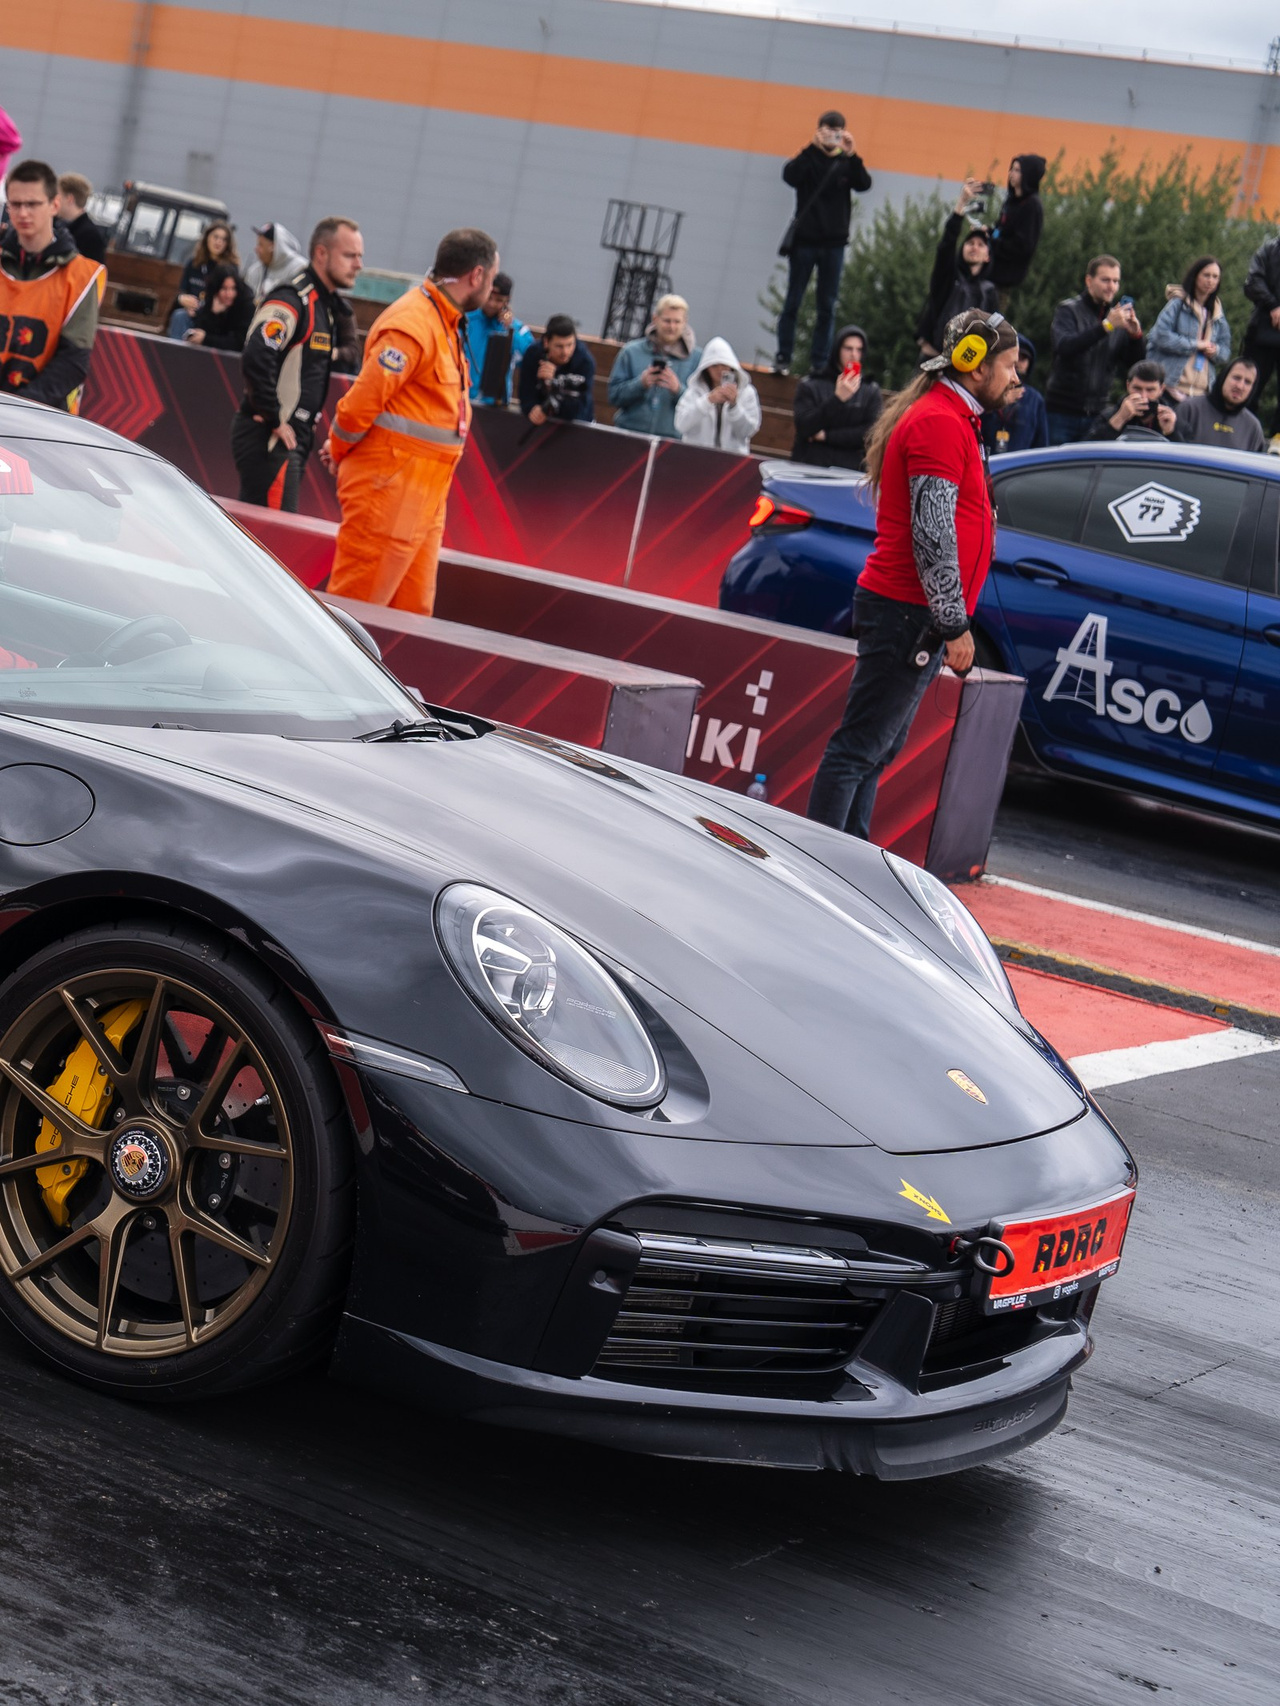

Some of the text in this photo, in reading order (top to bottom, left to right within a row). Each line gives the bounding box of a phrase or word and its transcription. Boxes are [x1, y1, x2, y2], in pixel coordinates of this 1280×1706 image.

[1138, 502, 1165, 522] 77
[49, 1074, 80, 1146] POCHE
[1032, 1217, 1107, 1274] RDRC
[993, 1294, 1027, 1310] VAGPLUS
